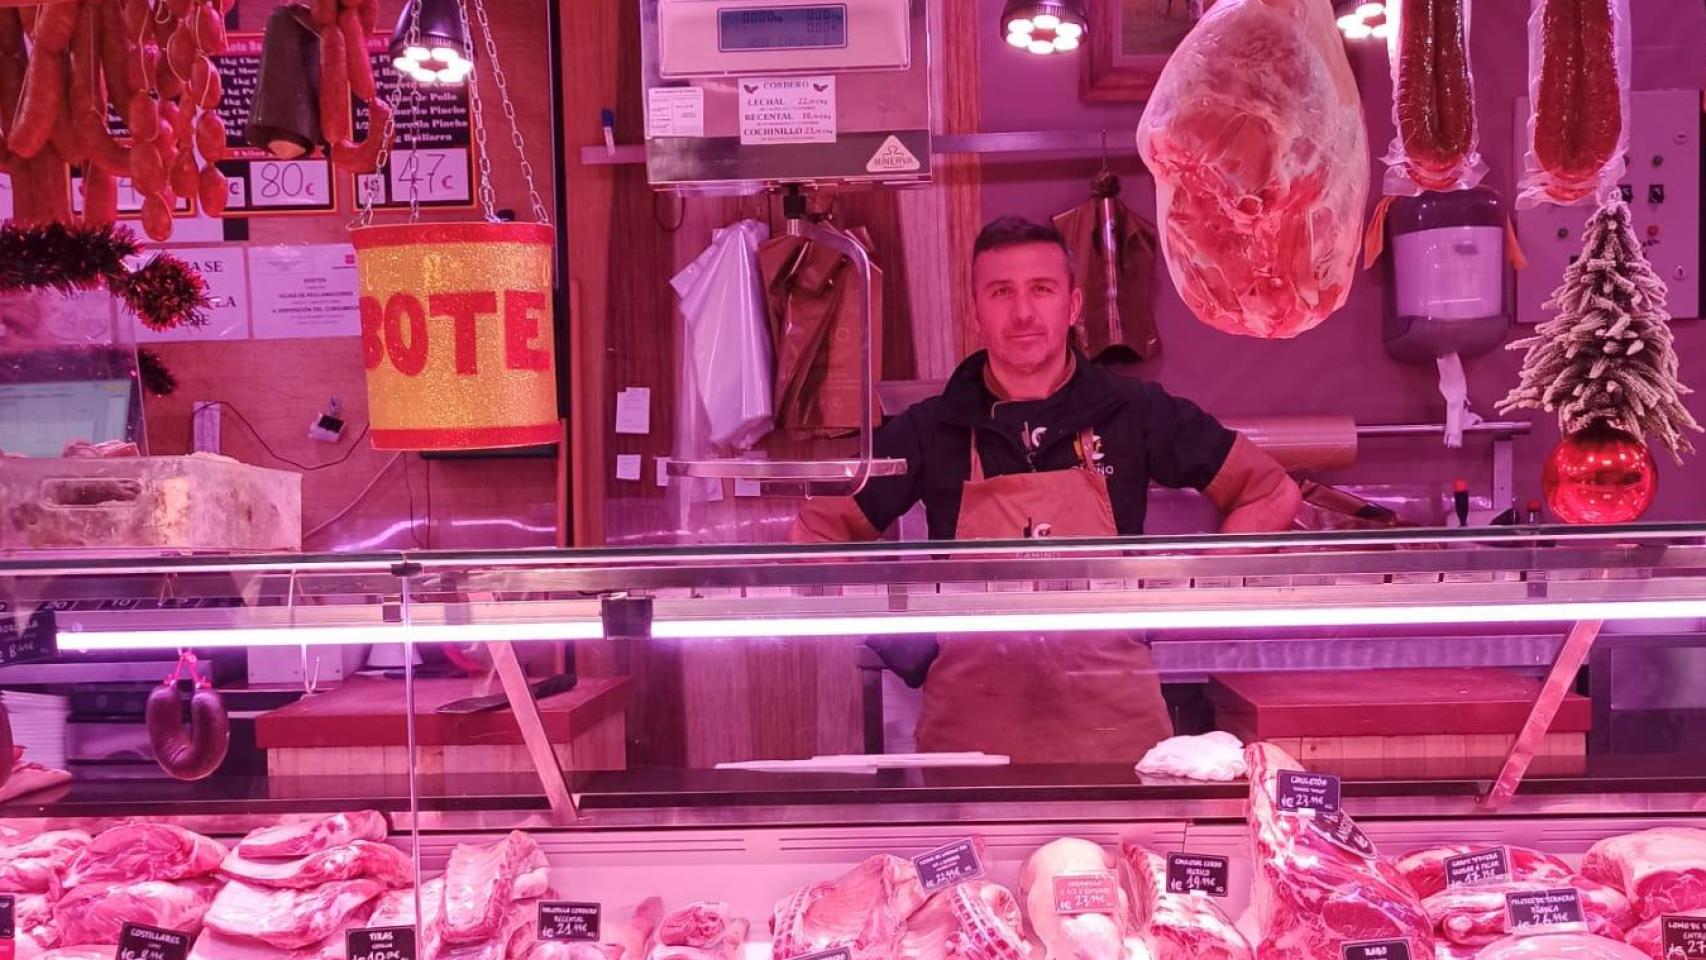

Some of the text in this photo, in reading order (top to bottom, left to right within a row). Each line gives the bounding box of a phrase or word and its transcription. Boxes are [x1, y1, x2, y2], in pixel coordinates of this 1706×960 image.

[763, 81, 809, 90] CORDERO
[747, 97, 785, 107] LECHAL
[744, 112, 793, 122] RECENTAL
[744, 127, 803, 136] COCHINILLO
[873, 156, 914, 167] MINERVA
[359, 288, 551, 377] BOTE
[1668, 921, 1690, 930] LOMO
[130, 927, 181, 945] COSTILLARES
[368, 931, 394, 941] TIRAS
[1364, 946, 1387, 956] RABO
